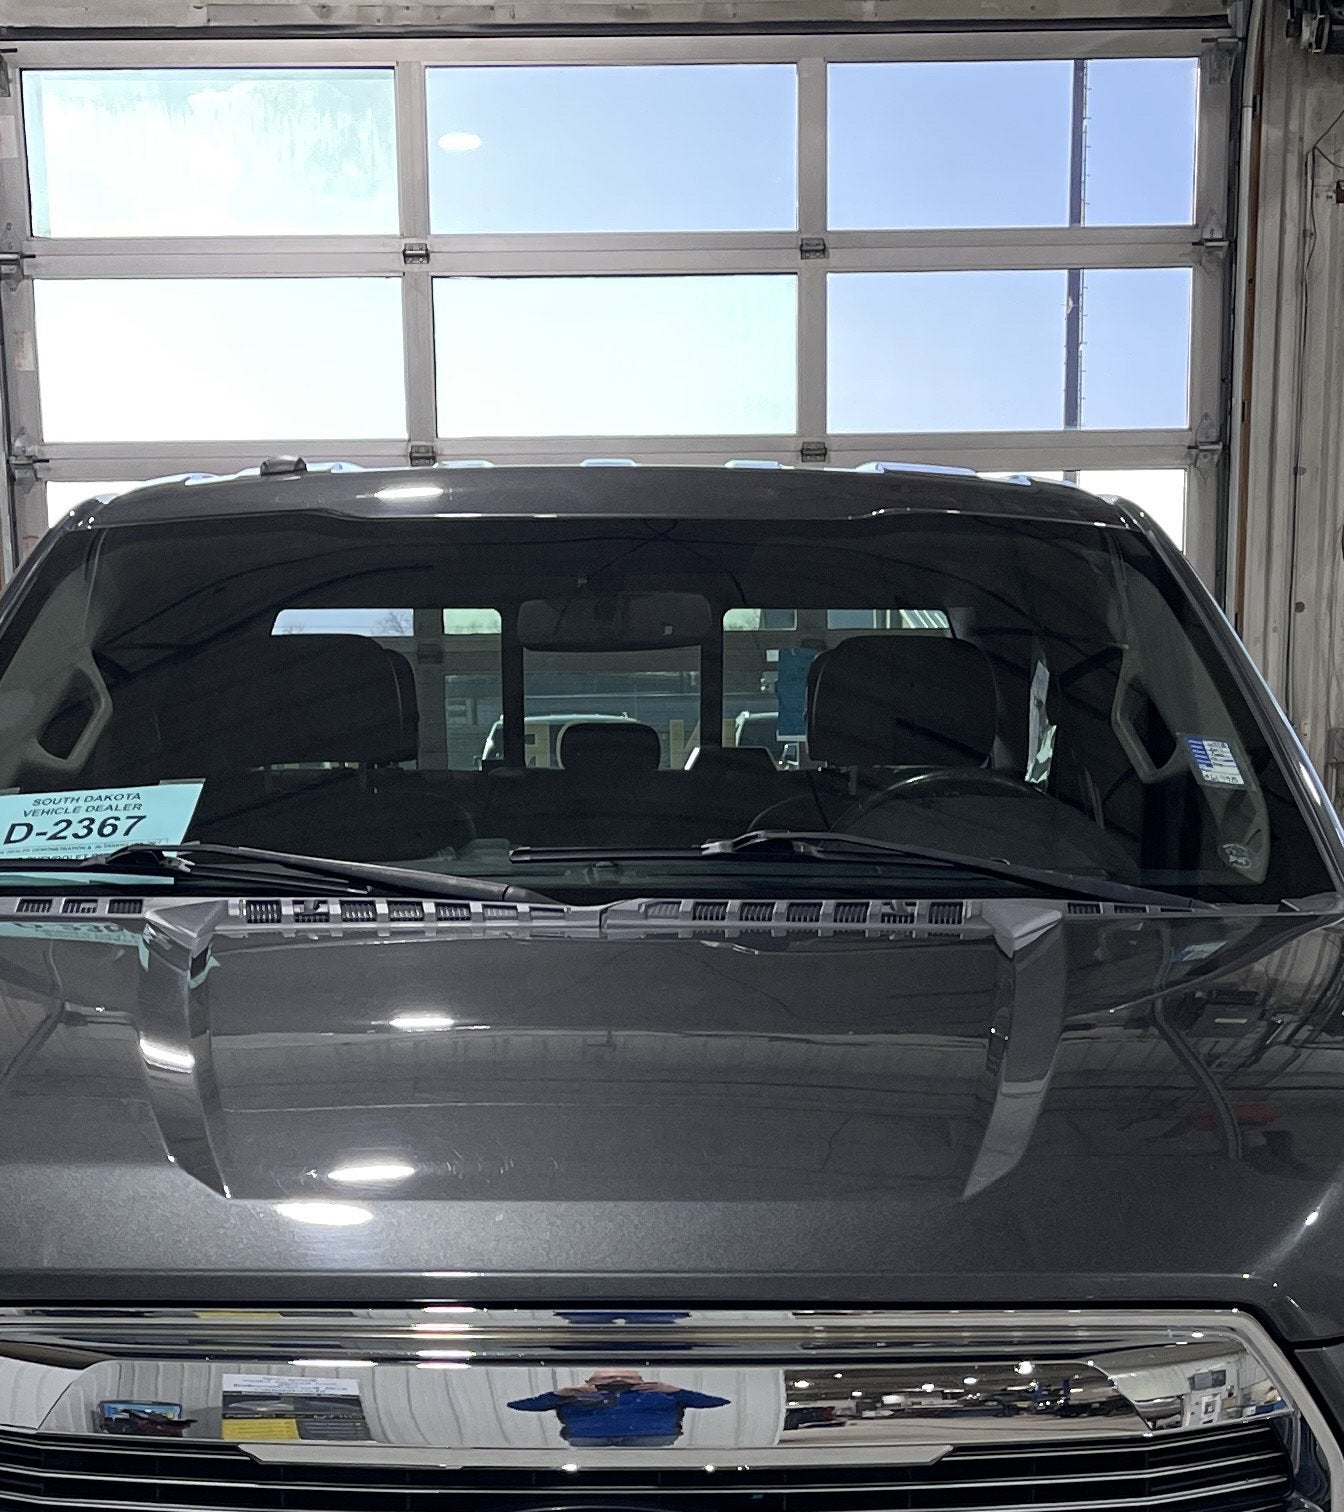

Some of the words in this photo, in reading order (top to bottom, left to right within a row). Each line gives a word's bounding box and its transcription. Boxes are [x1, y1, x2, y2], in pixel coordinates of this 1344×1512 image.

[32, 796, 81, 807] SOUTH
[83, 792, 142, 803] DAKOTA
[23, 805, 82, 818] VEHICLE
[85, 803, 143, 813] DEALER
[3, 815, 147, 845] D-2367
